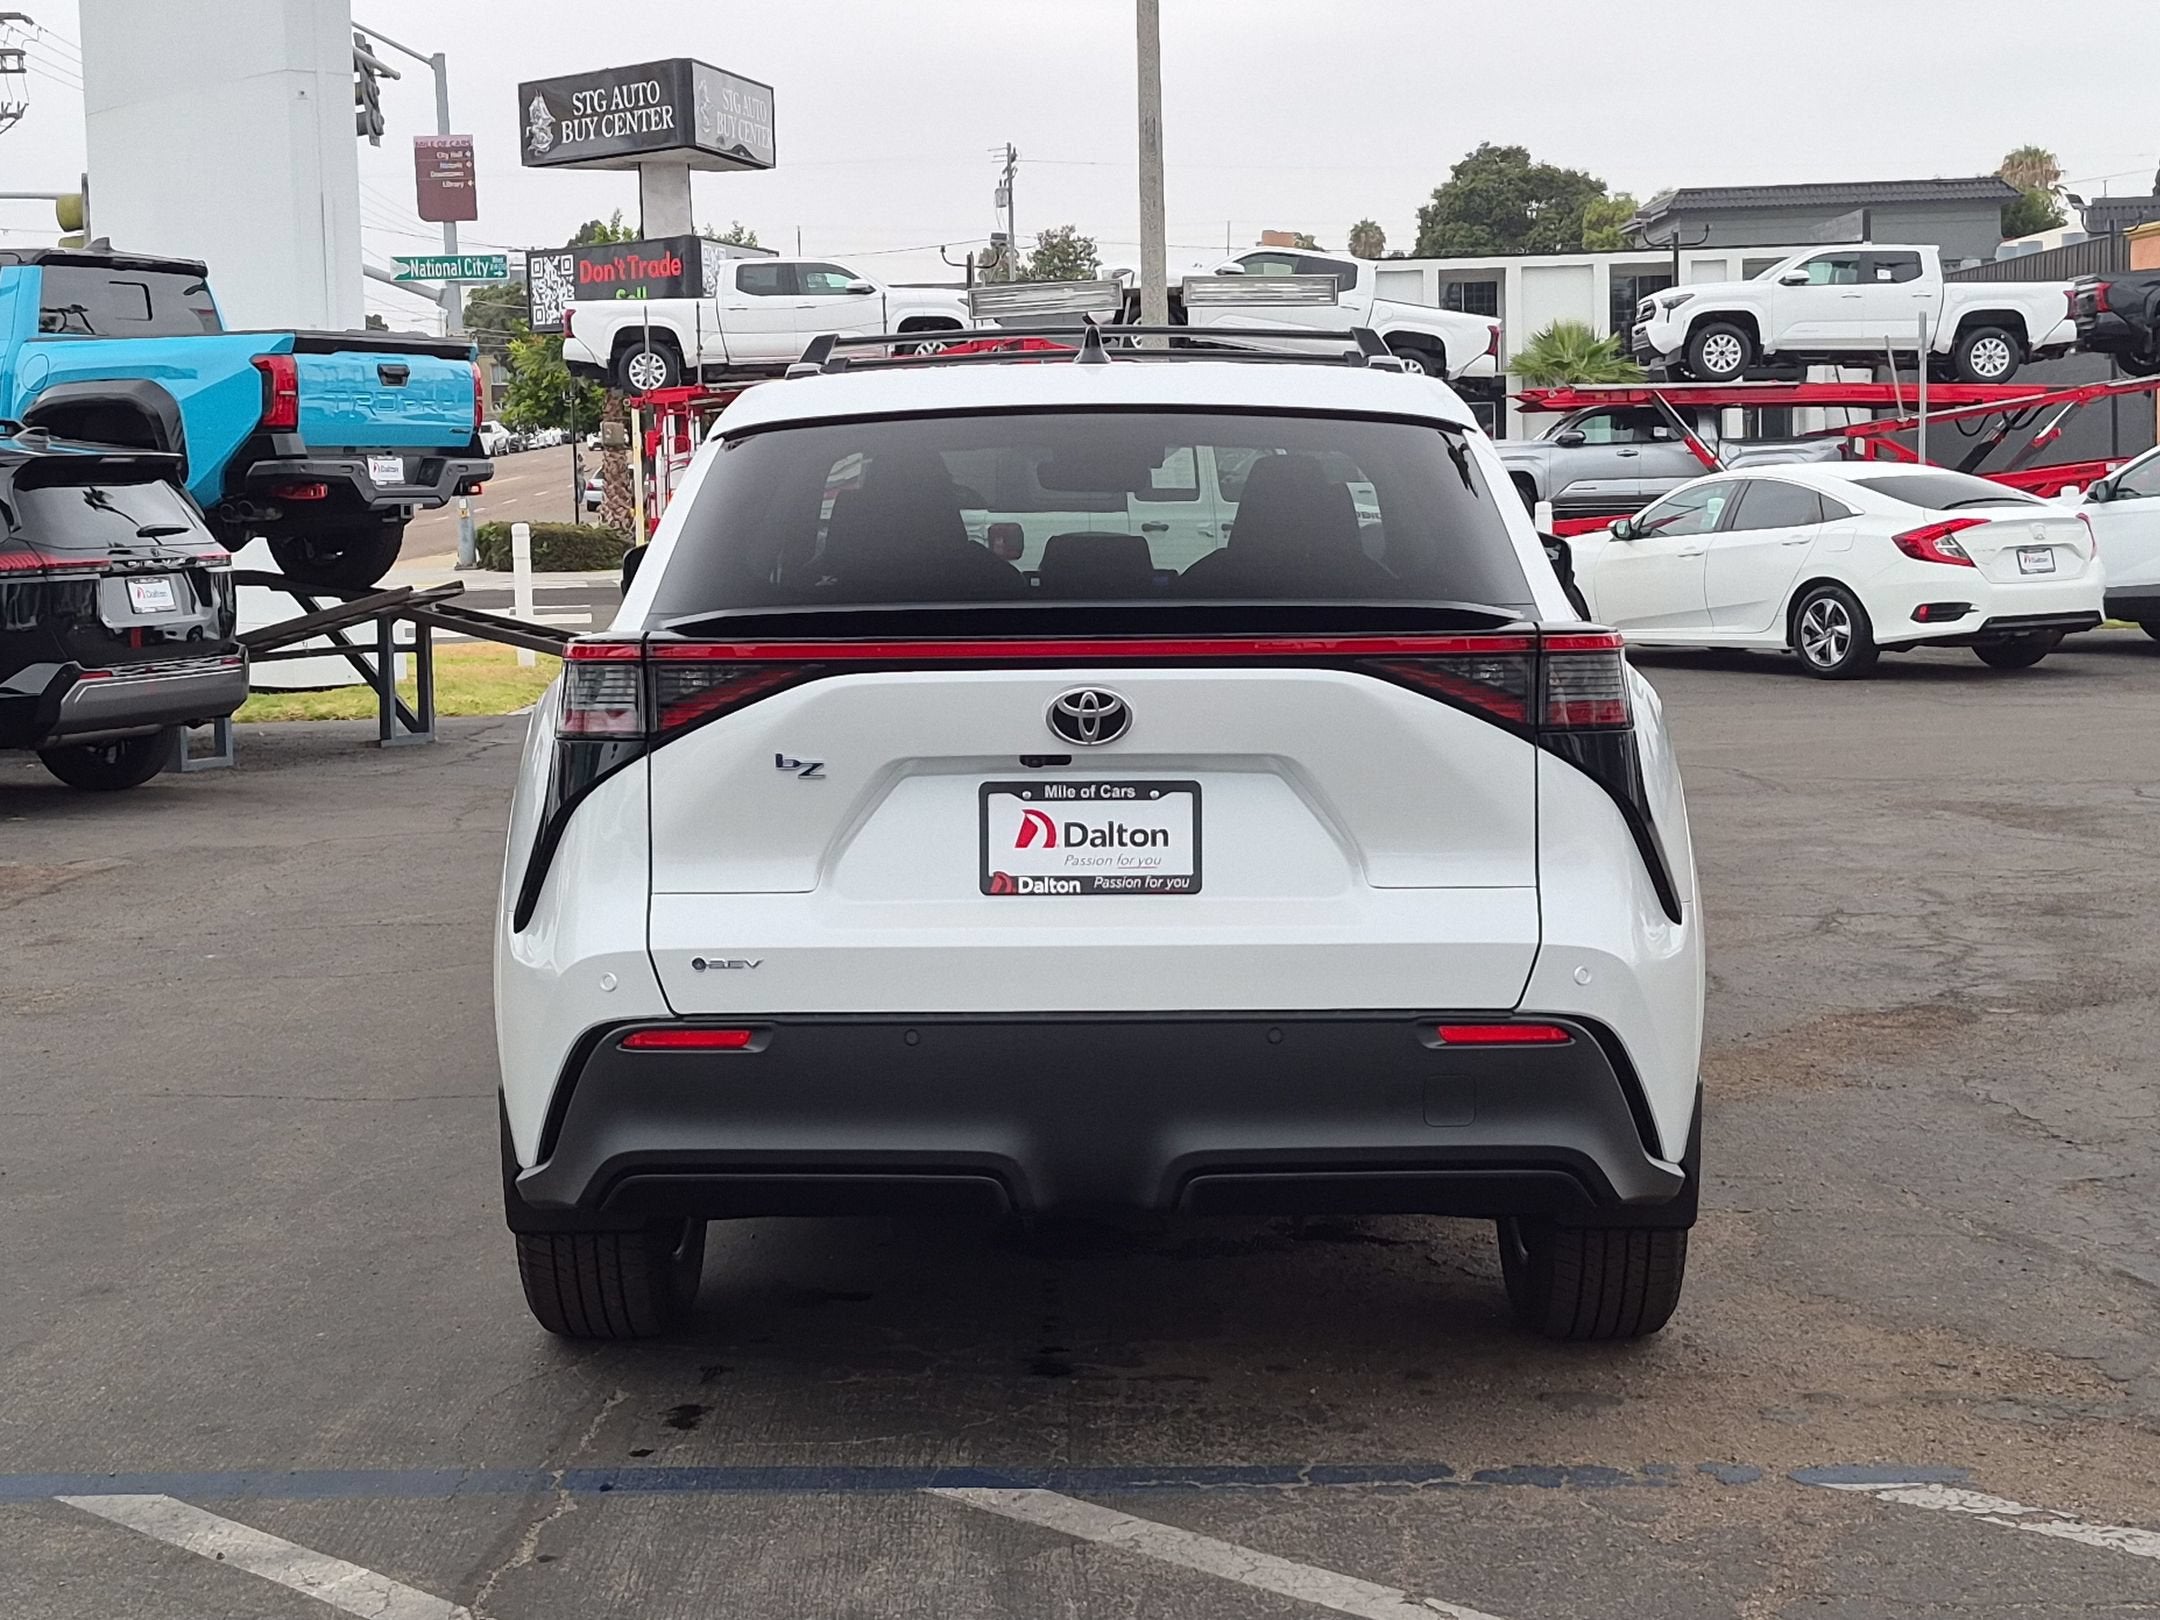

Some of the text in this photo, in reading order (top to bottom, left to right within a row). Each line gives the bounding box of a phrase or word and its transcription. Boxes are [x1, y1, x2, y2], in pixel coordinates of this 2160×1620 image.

[572, 80, 661, 116] STG AUTO
[722, 88, 767, 121] STG AUTO
[561, 105, 675, 144] BUY CENTER
[717, 111, 737, 139] BUY
[410, 257, 490, 278] National City
[579, 251, 682, 284] Don't Trade
[1044, 785, 1136, 798] Mile of Cars
[1064, 821, 1169, 848] Dalton
[1064, 854, 1162, 868] Passion for you
[1018, 876, 1190, 894] Dalton Passion for you
